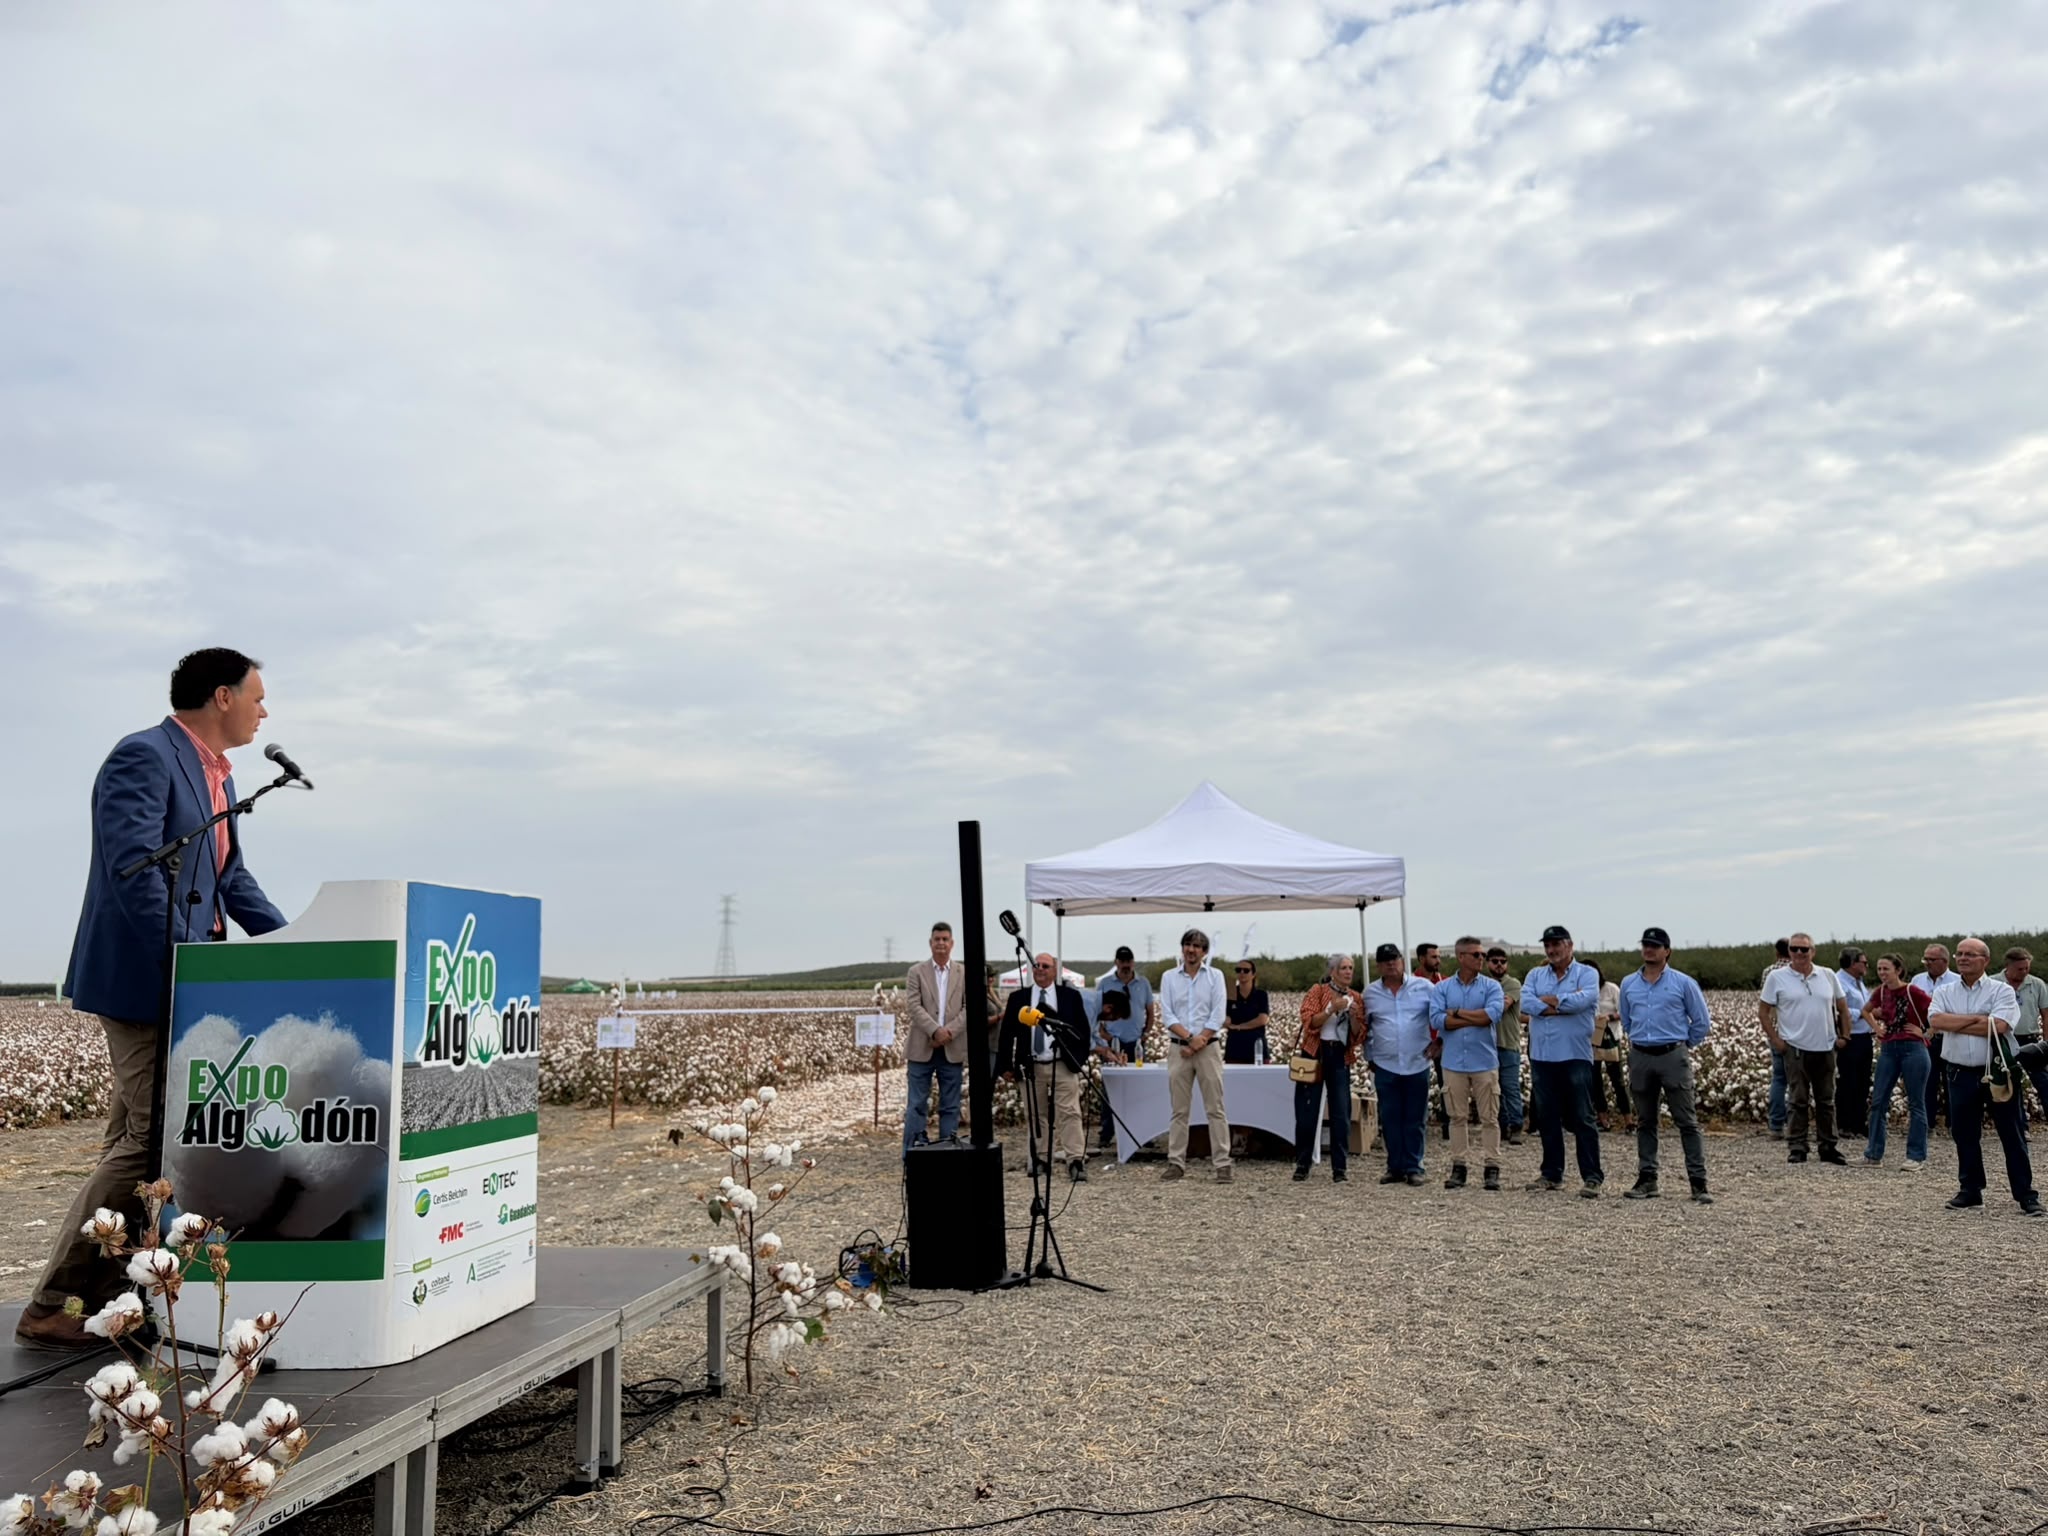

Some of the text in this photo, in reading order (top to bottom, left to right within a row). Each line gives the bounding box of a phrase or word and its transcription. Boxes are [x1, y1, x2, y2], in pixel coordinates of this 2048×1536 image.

[427, 919, 494, 1008] Expo
[186, 1038, 288, 1106] Expo
[483, 1171, 516, 1195] ENTEC
[440, 1221, 464, 1244] FMC
[269, 1498, 314, 1525] GUIL
